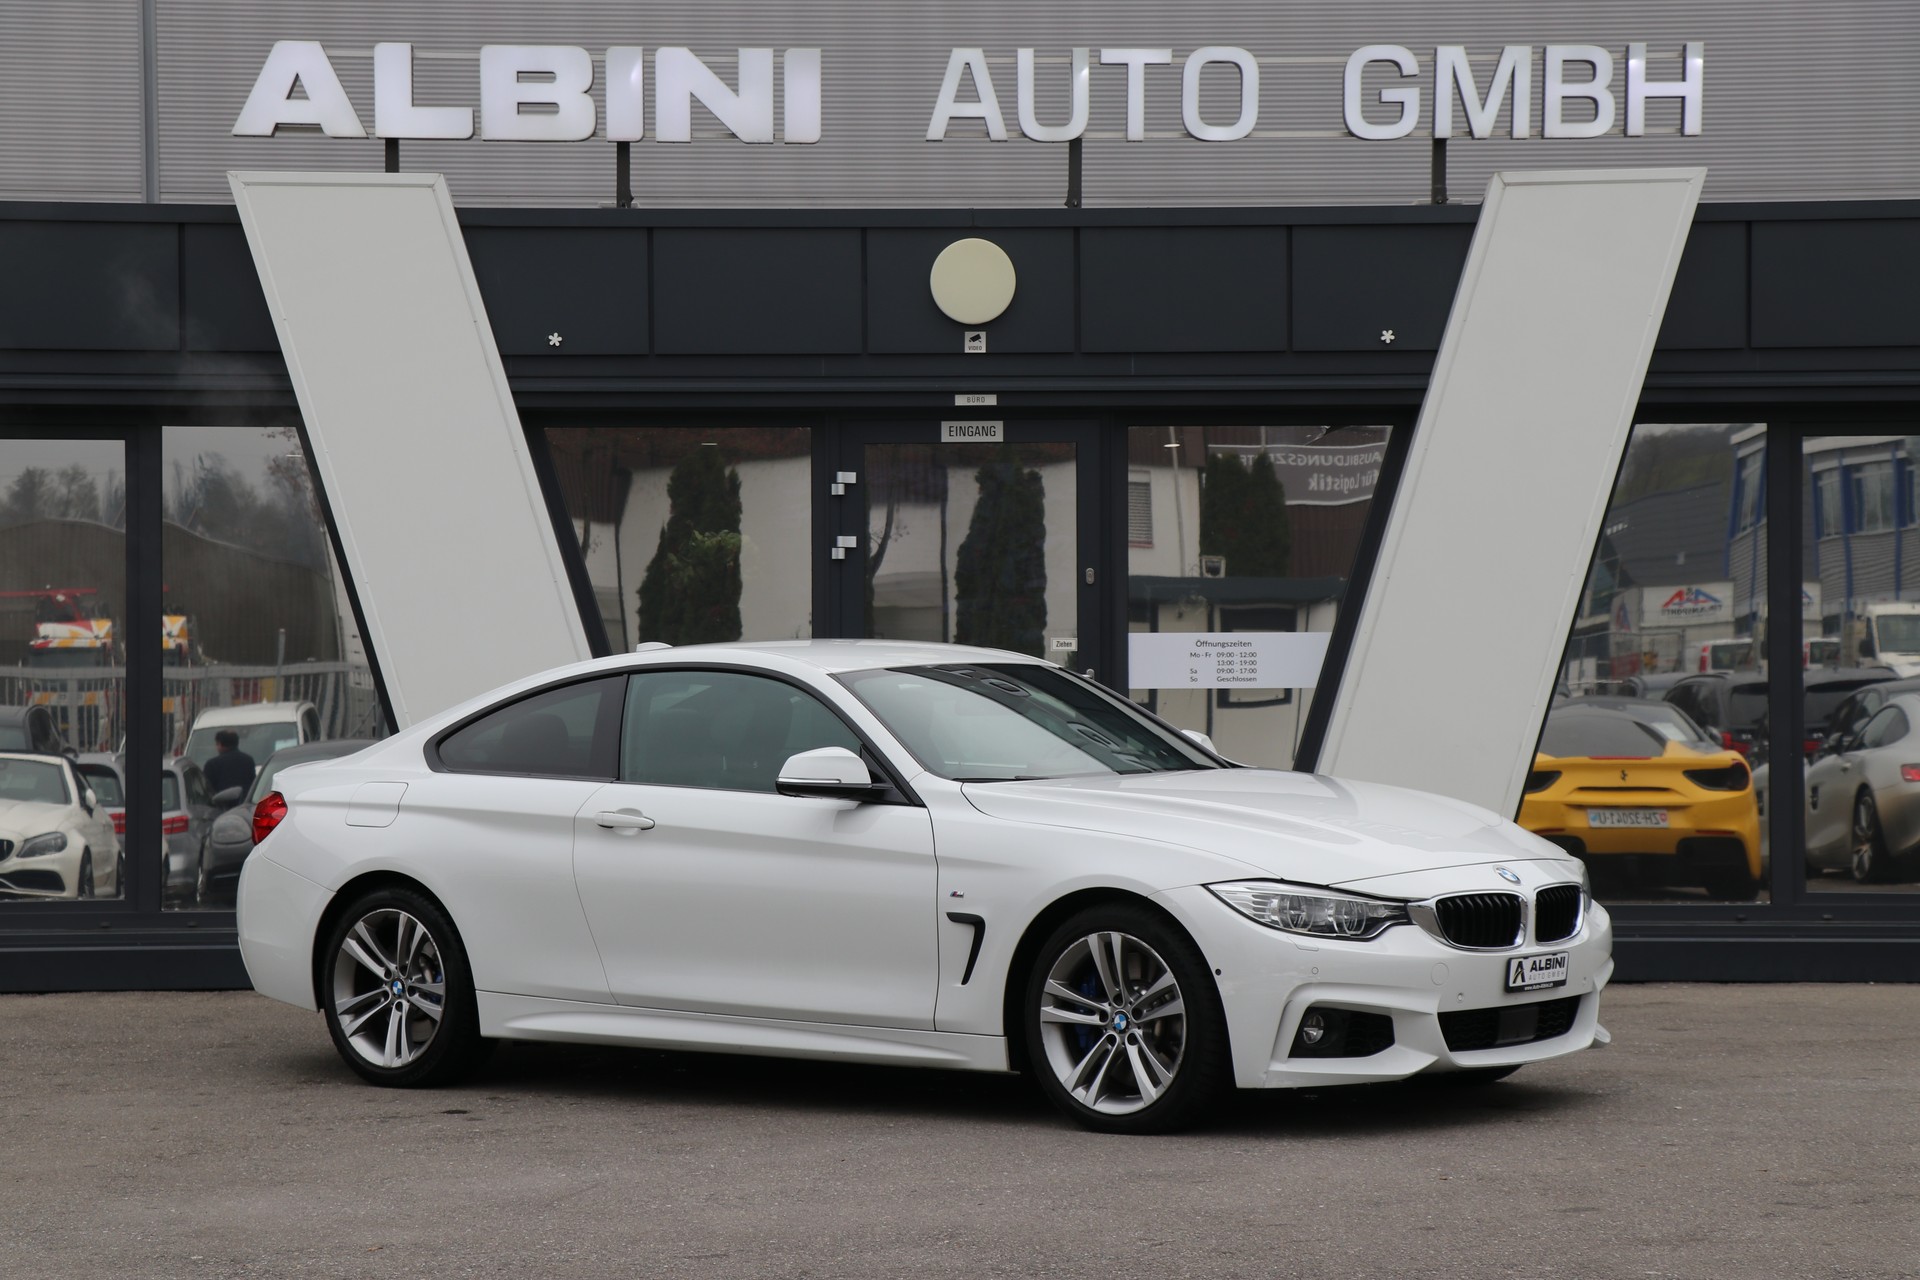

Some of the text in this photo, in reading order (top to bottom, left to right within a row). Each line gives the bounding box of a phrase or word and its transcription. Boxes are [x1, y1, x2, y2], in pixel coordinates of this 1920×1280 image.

[231, 40, 1705, 144] ALBINI AUTO GMBH
[966, 395, 986, 403] BÜRO
[948, 425, 997, 437] EINGANG
[1055, 640, 1073, 648] Ziehen
[1195, 639, 1252, 649] Öffnungszeiten
[1530, 956, 1566, 973] ALBINI
[1529, 972, 1546, 981] AUTO
